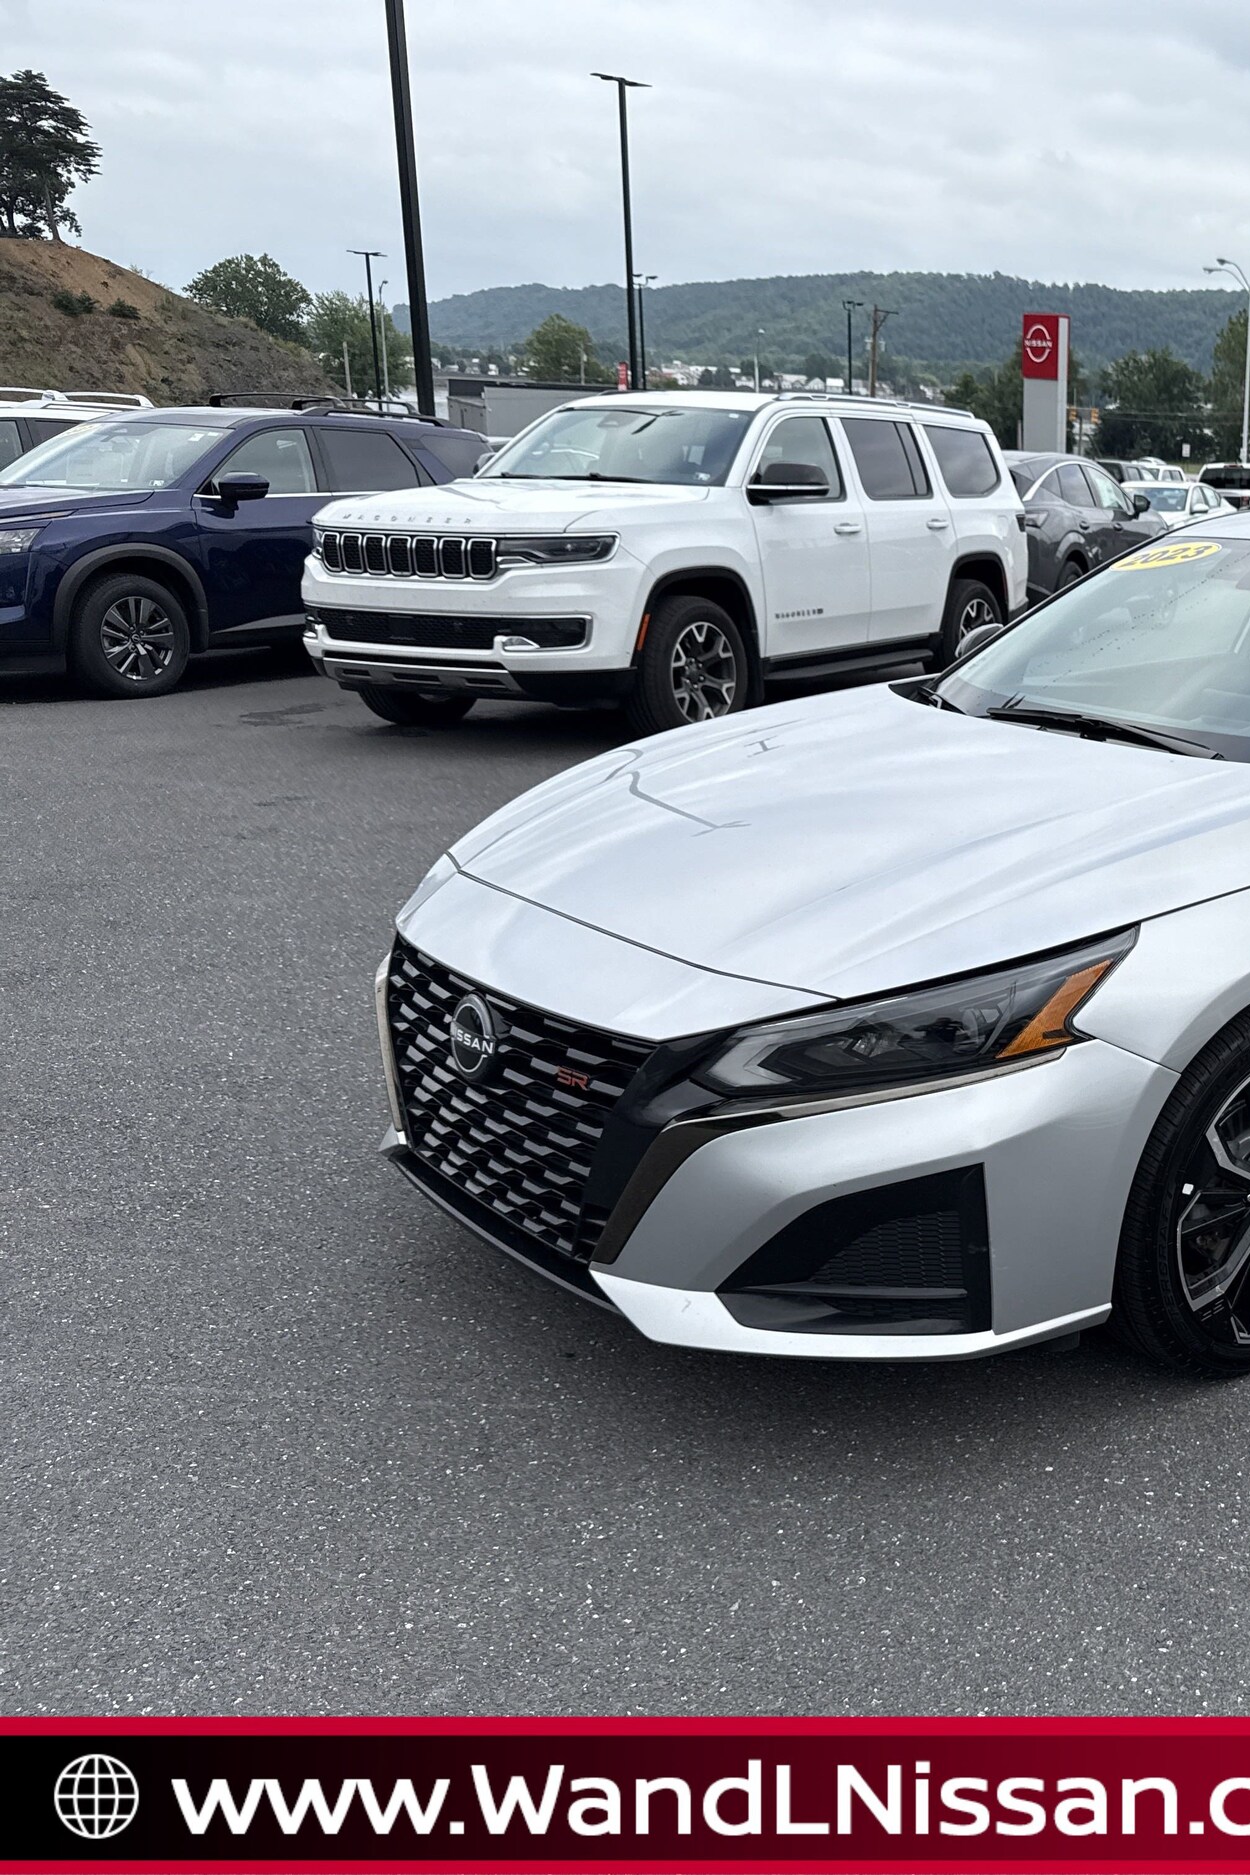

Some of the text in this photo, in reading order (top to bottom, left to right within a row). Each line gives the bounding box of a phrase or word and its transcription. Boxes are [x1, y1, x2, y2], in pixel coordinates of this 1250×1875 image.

[1024, 339, 1053, 348] NISSAN
[1116, 545, 1214, 568] 2023
[556, 1066, 590, 1091] SR
